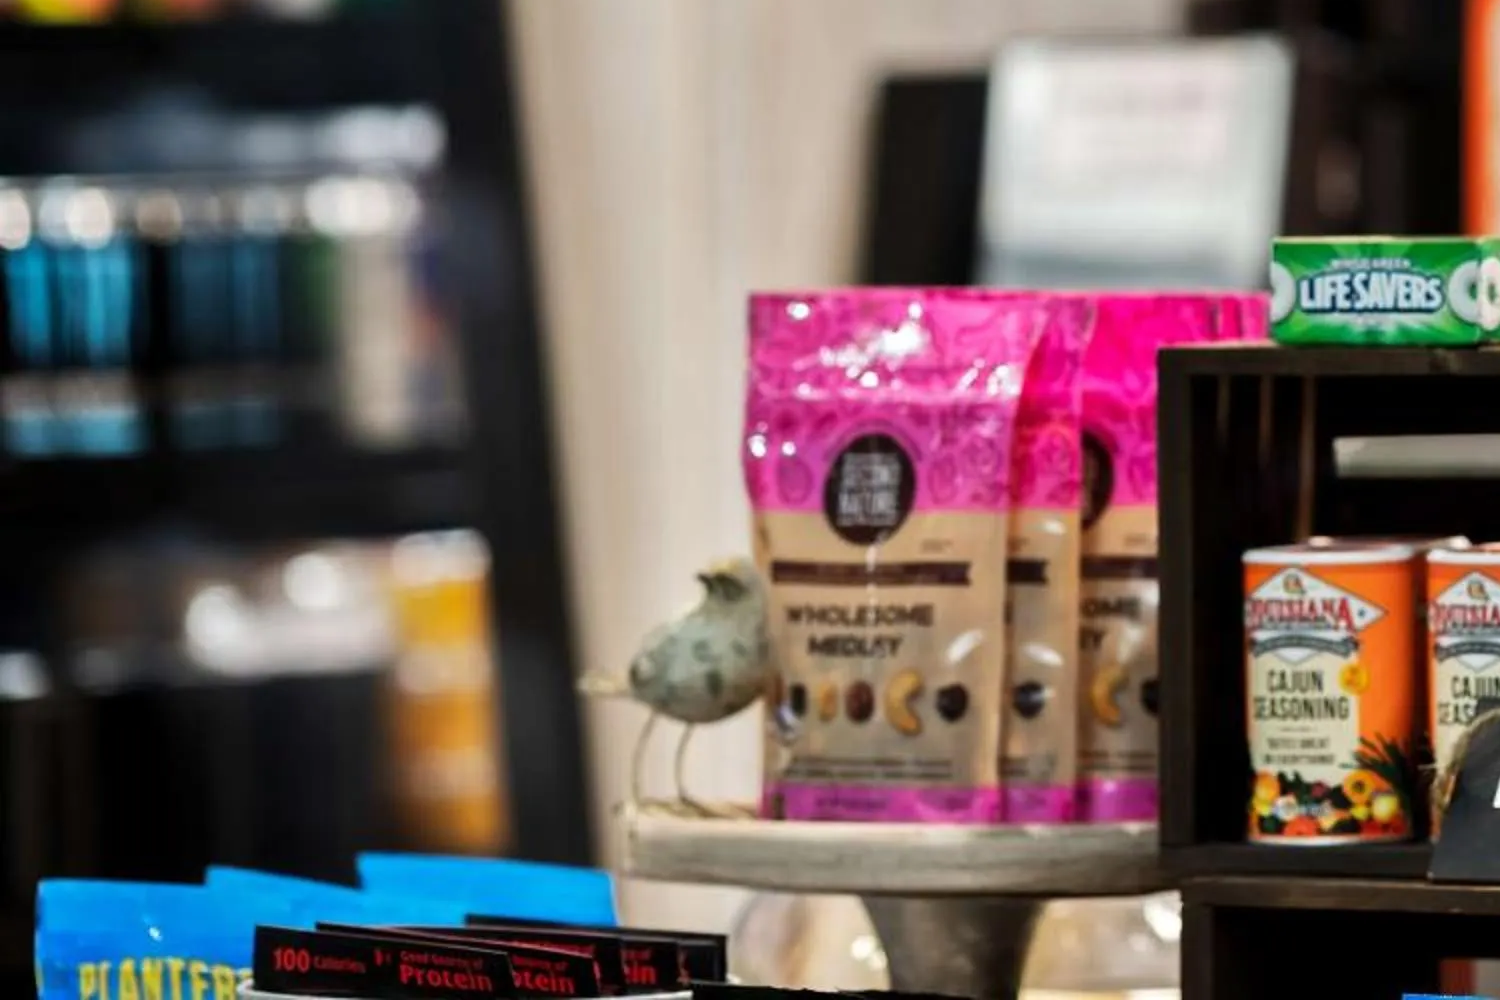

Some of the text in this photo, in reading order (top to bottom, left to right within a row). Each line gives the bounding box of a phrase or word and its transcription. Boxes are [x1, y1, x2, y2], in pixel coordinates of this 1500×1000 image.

[785, 603, 934, 628] WHOLESOME
[807, 634, 904, 660] MEDLEY
[1266, 669, 1325, 694] CAJUN
[1253, 696, 1350, 721] SEASONING
[273, 947, 311, 973] 100
[79, 957, 253, 1000] PLANTER
[398, 963, 494, 992] Protein
